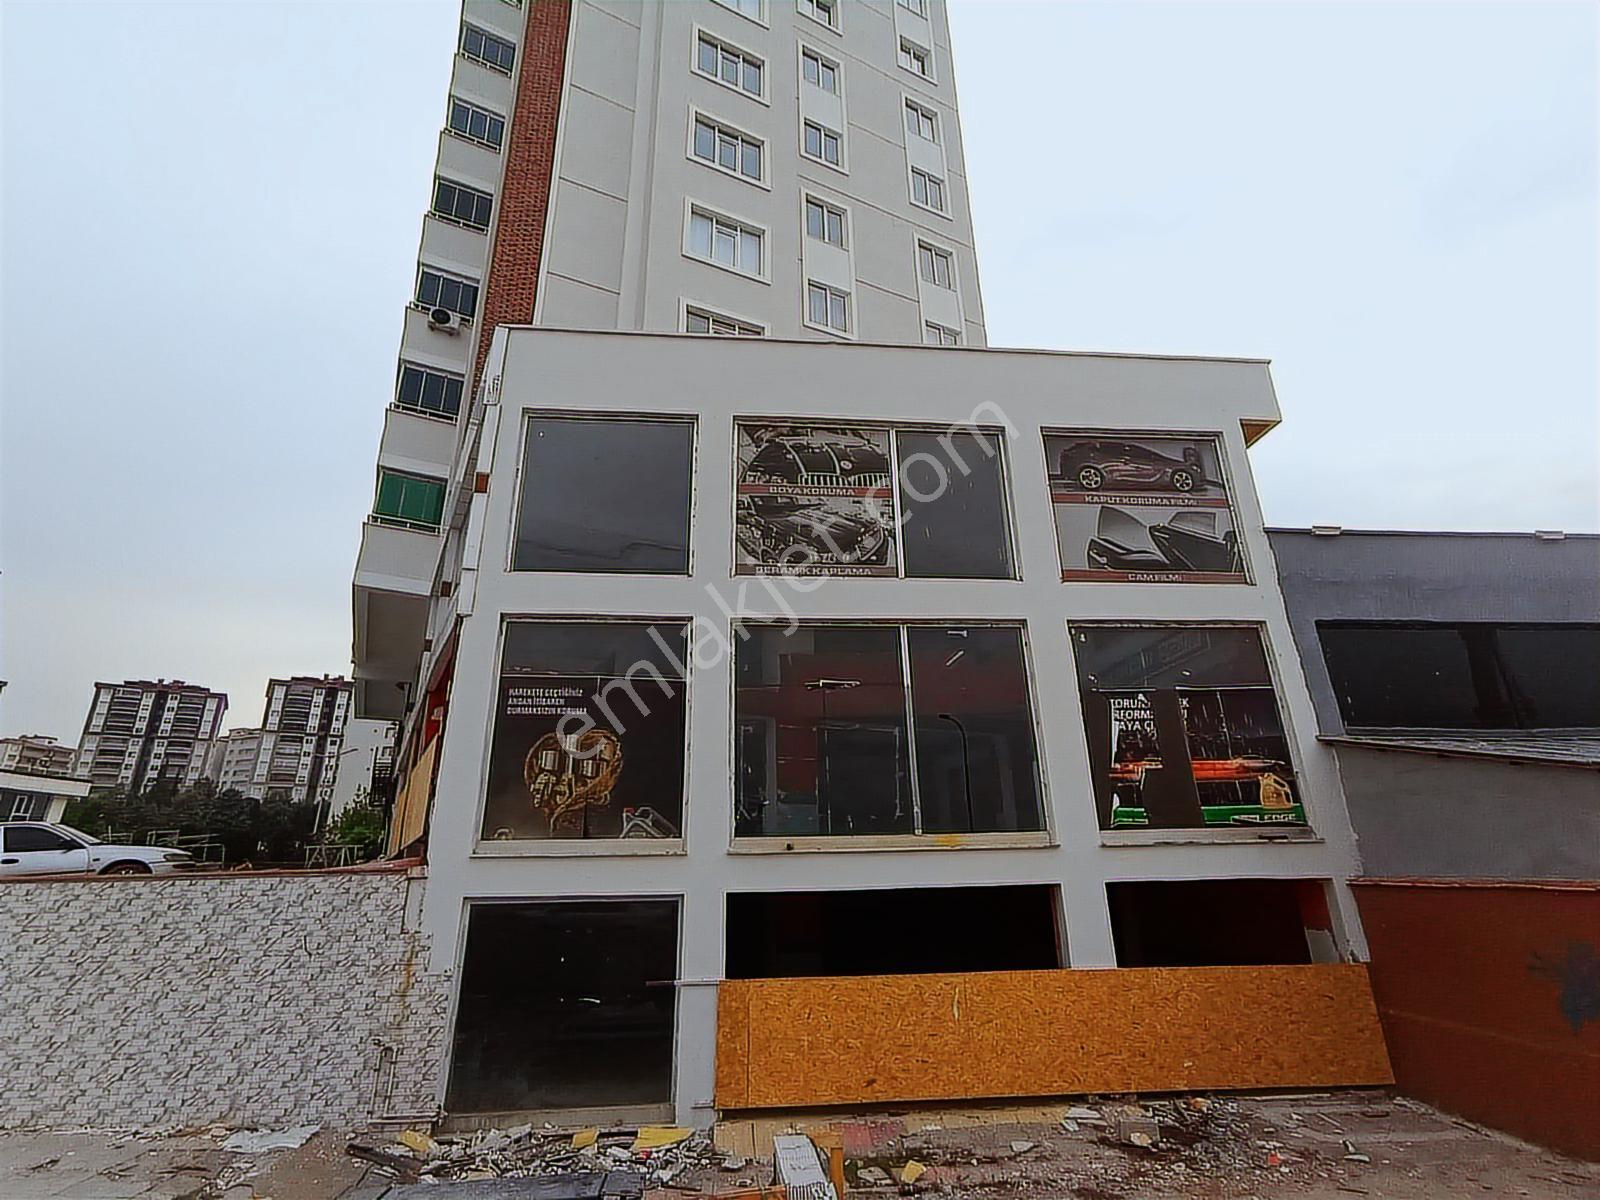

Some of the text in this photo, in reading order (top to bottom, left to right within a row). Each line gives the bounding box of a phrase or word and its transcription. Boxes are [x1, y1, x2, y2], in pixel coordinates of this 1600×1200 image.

[769, 486, 856, 495] BOYA KORUMA
[1122, 496, 1169, 504] KORUMA
